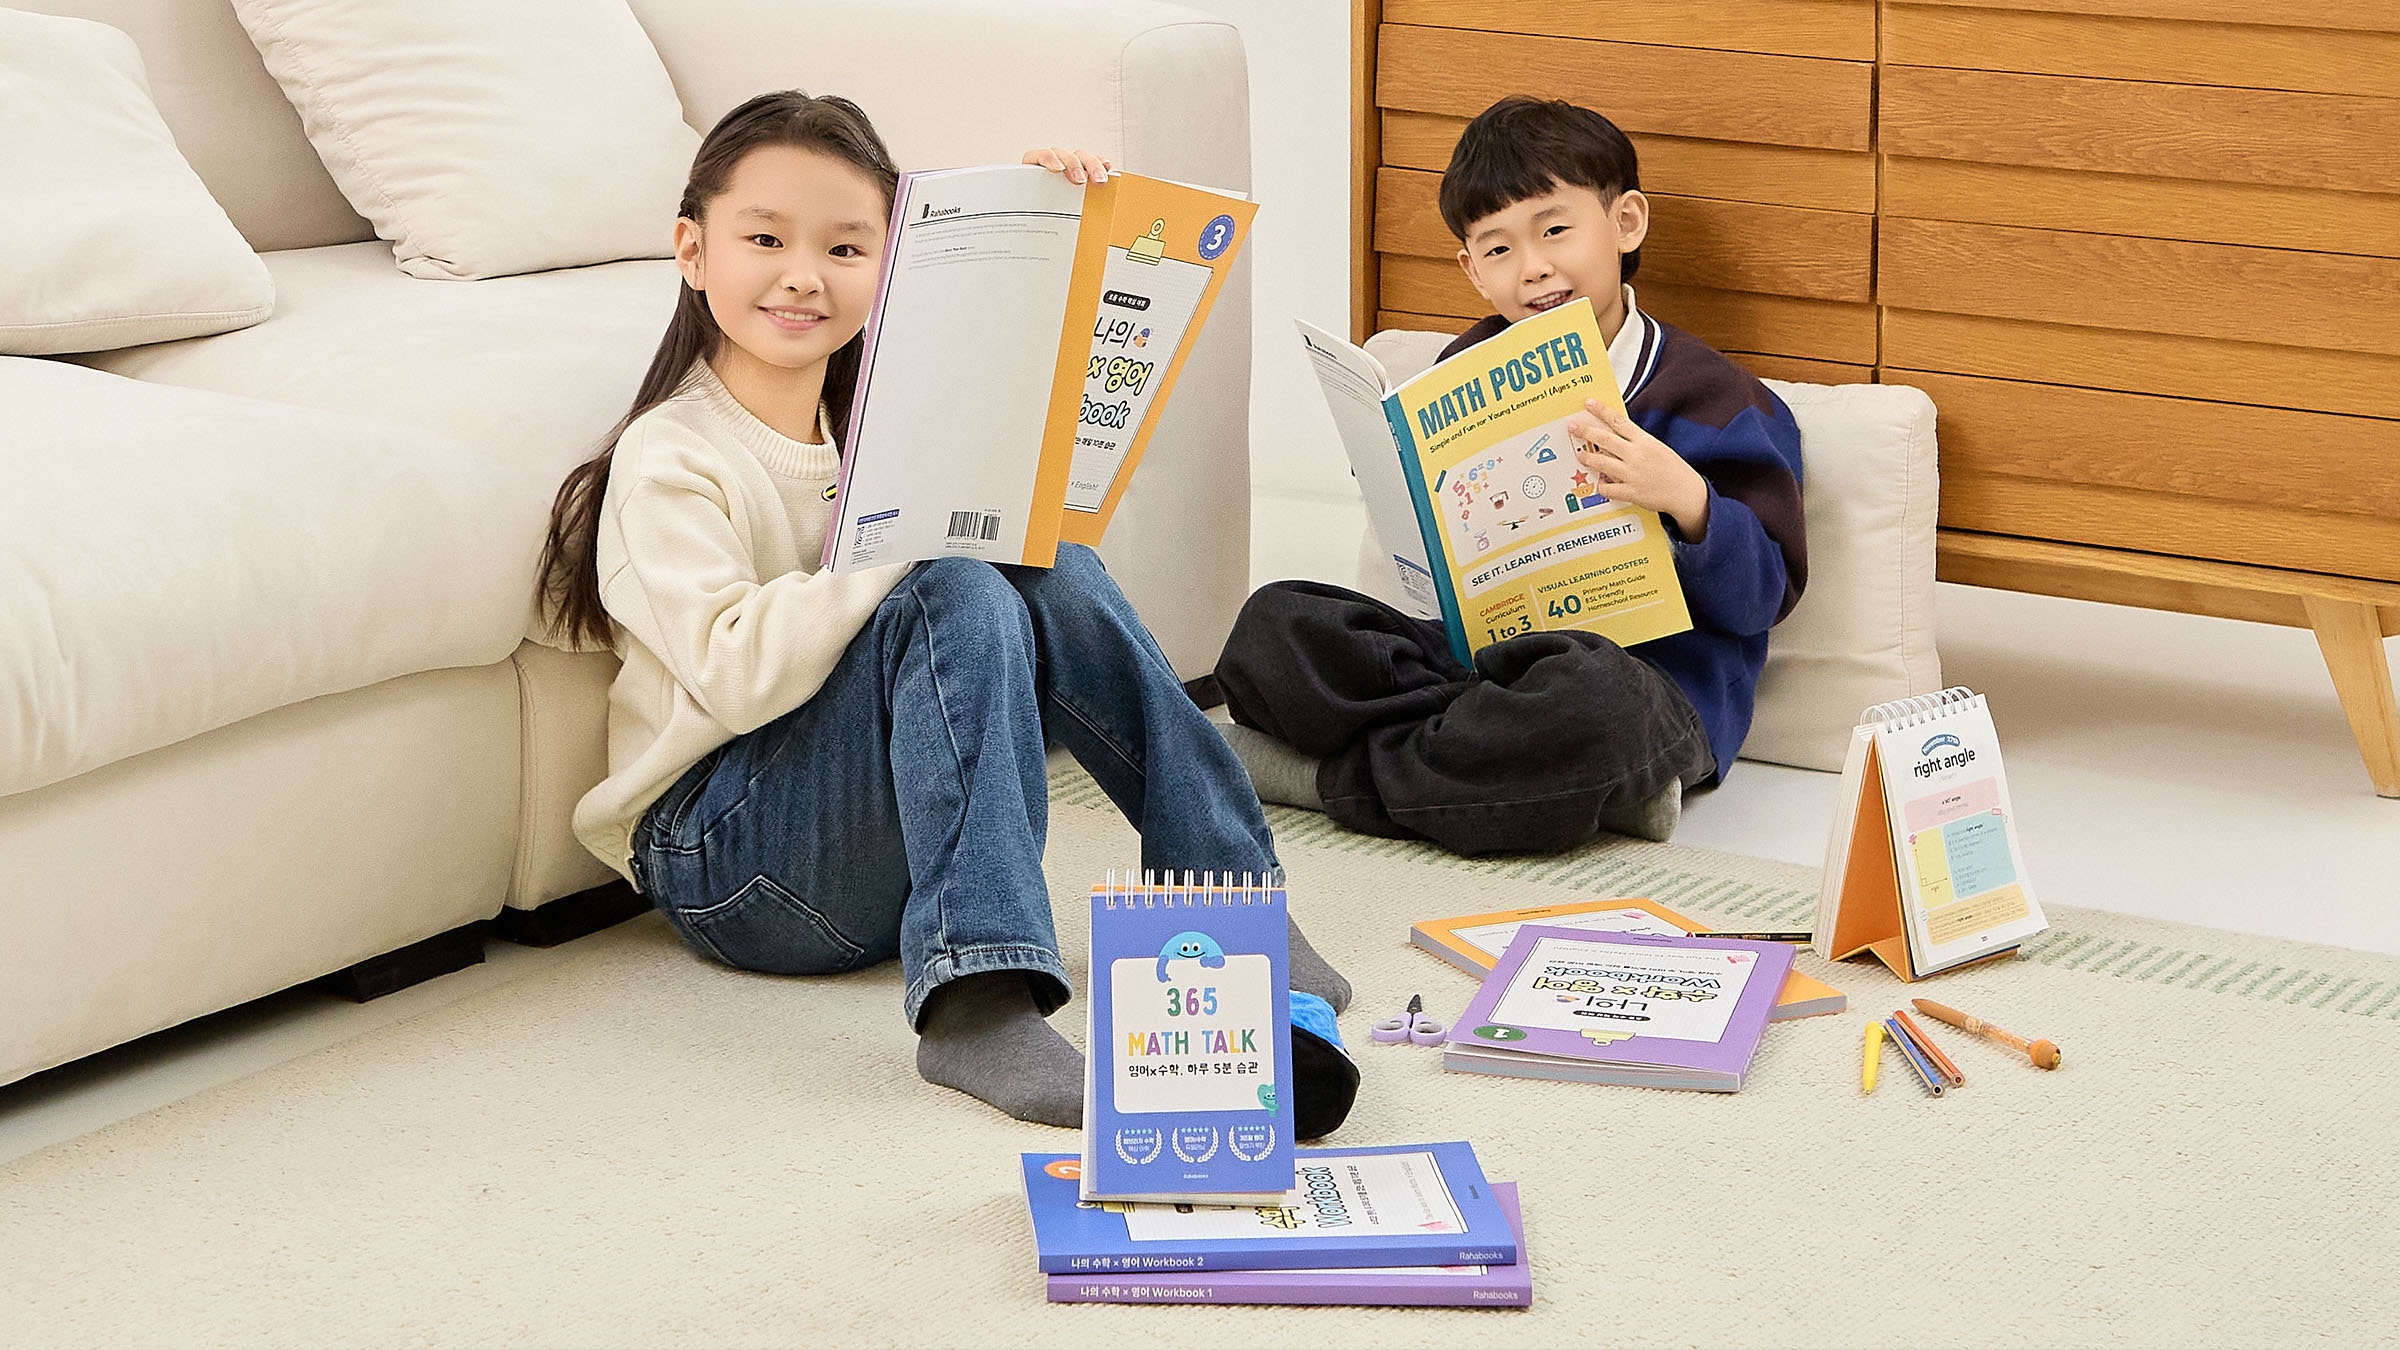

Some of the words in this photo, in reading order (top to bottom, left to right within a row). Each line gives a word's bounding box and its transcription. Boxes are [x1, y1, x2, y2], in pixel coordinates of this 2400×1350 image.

[1206, 224, 1227, 251] 3
[1094, 316, 1136, 348] 나의
[1105, 356, 1154, 396] 영어
[1416, 377, 1487, 440] MATH
[1488, 331, 1589, 401] POSTER
[1429, 437, 1451, 454] Simple
[1451, 430, 1463, 441] and
[1463, 423, 1476, 438] Fun
[1476, 417, 1487, 427] for
[1487, 408, 1511, 422] Young
[1510, 391, 1548, 411] Learners!
[1549, 382, 1571, 396] (Ages
[1572, 374, 1593, 387] 5-10)
[1472, 571, 1491, 587] SEE
[1491, 566, 1504, 578] IT.
[1504, 551, 1541, 572] LEARN
[1542, 546, 1556, 558] IT.
[1556, 526, 1621, 552] REMEMBER
[1622, 523, 1637, 534] IT.
[1538, 582, 1568, 593] VISUAL
[1569, 568, 1612, 585] LEARNING
[1612, 557, 1650, 573] POSTERS
[1582, 584, 1608, 596] Primary
[1609, 579, 1627, 588] Math
[1626, 574, 1646, 584] Guide
[1480, 593, 1525, 617] CAMBRIDGE
[1548, 594, 1581, 618] 40
[1585, 596, 1598, 604] ESL
[1598, 589, 1625, 600] Friendly
[1587, 596, 1629, 612] Homeschool
[1629, 589, 1658, 601] Resource
[1485, 604, 1526, 624] Curriculum
[1487, 628, 1497, 643] 1
[1499, 626, 1517, 639] to
[1518, 614, 1532, 631] 3
[1914, 757, 1943, 778] right
[1944, 748, 1976, 767] angle
[1533, 976, 1605, 993] 영어
[1543, 965, 1722, 989] Workbook
[1167, 987, 1218, 1016] 365
[1586, 995, 1648, 1011] 나의
[1640, 986, 1718, 1002] 수학
[1128, 1031, 1189, 1057] MATH
[1201, 1028, 1258, 1054] TALK
[1187, 1063, 1209, 1076] 하루
[1213, 1062, 1232, 1075] 5분
[1236, 1062, 1259, 1074] 습관
[1295, 1165, 1352, 1229] Workbook
[1071, 1258, 1090, 1270] 나의
[1092, 1257, 1110, 1270] 수학
[1122, 1257, 1140, 1268] 영어
[1142, 1256, 1195, 1268] Workbook
[1197, 1256, 1204, 1267] 2
[1459, 1251, 1504, 1261] Rahabooks
[1080, 1285, 1099, 1298] 나의
[1101, 1285, 1120, 1298] 수학
[1131, 1286, 1149, 1298] 영어
[1151, 1287, 1205, 1299] Workbook
[1207, 1288, 1213, 1297] 1
[1473, 1290, 1519, 1300] Rahabooks
